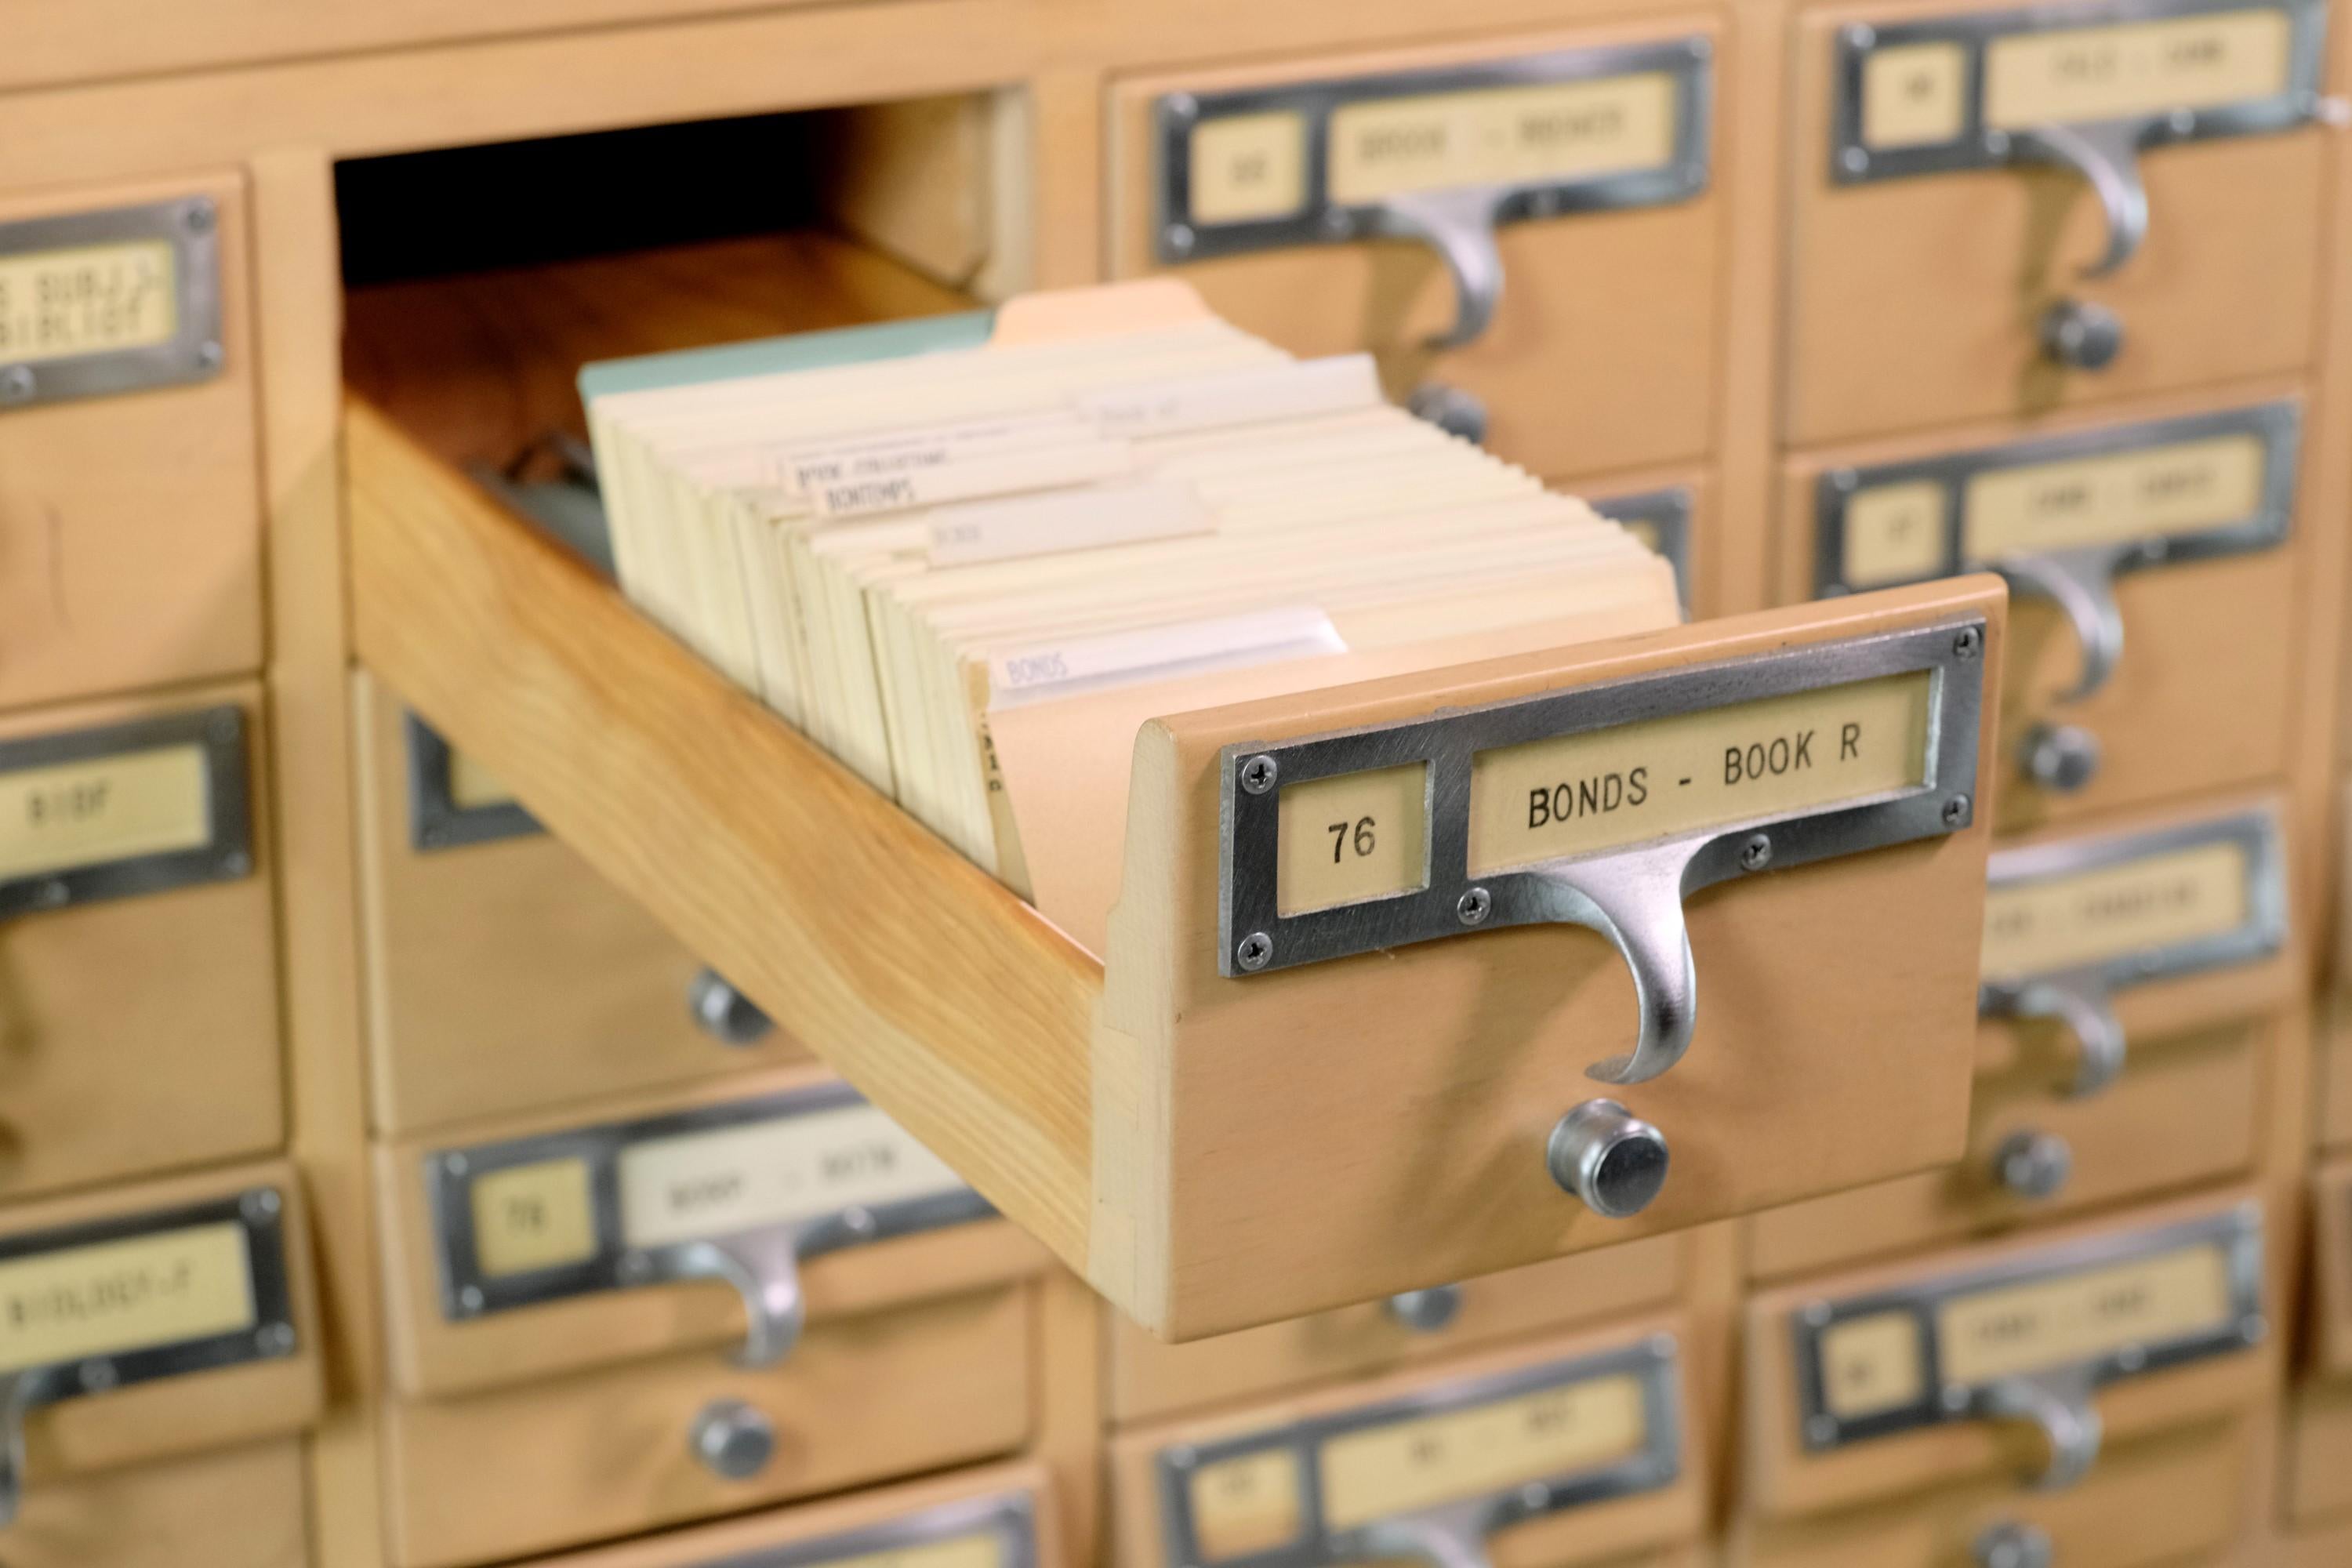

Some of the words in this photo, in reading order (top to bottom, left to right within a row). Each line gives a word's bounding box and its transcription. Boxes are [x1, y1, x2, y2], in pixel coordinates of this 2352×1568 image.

[1006, 652, 1069, 685] BONDS
[1528, 767, 1648, 829] BONDS
[1679, 777, 1692, 786] -
[1725, 729, 1815, 786] BOOK
[1840, 723, 1861, 762] R
[1328, 816, 1376, 863] 76
